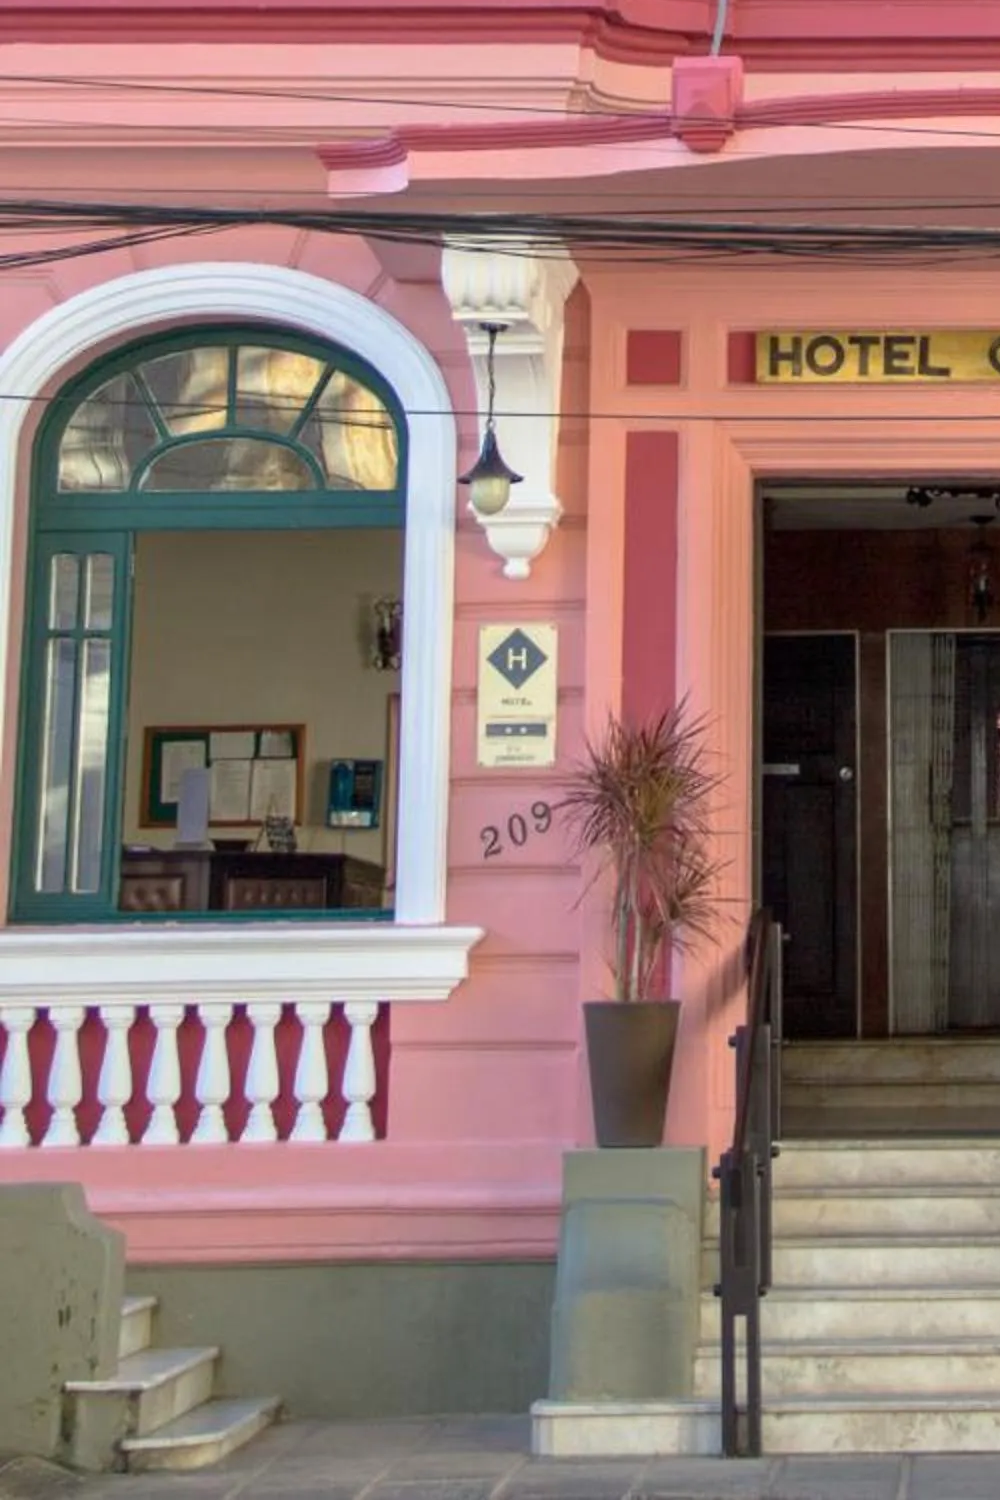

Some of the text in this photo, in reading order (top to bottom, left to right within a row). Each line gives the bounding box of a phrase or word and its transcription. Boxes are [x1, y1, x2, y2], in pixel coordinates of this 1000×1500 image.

[768, 335, 950, 377] HOTEL
[507, 647, 527, 671] H
[480, 801, 552, 859] 209
